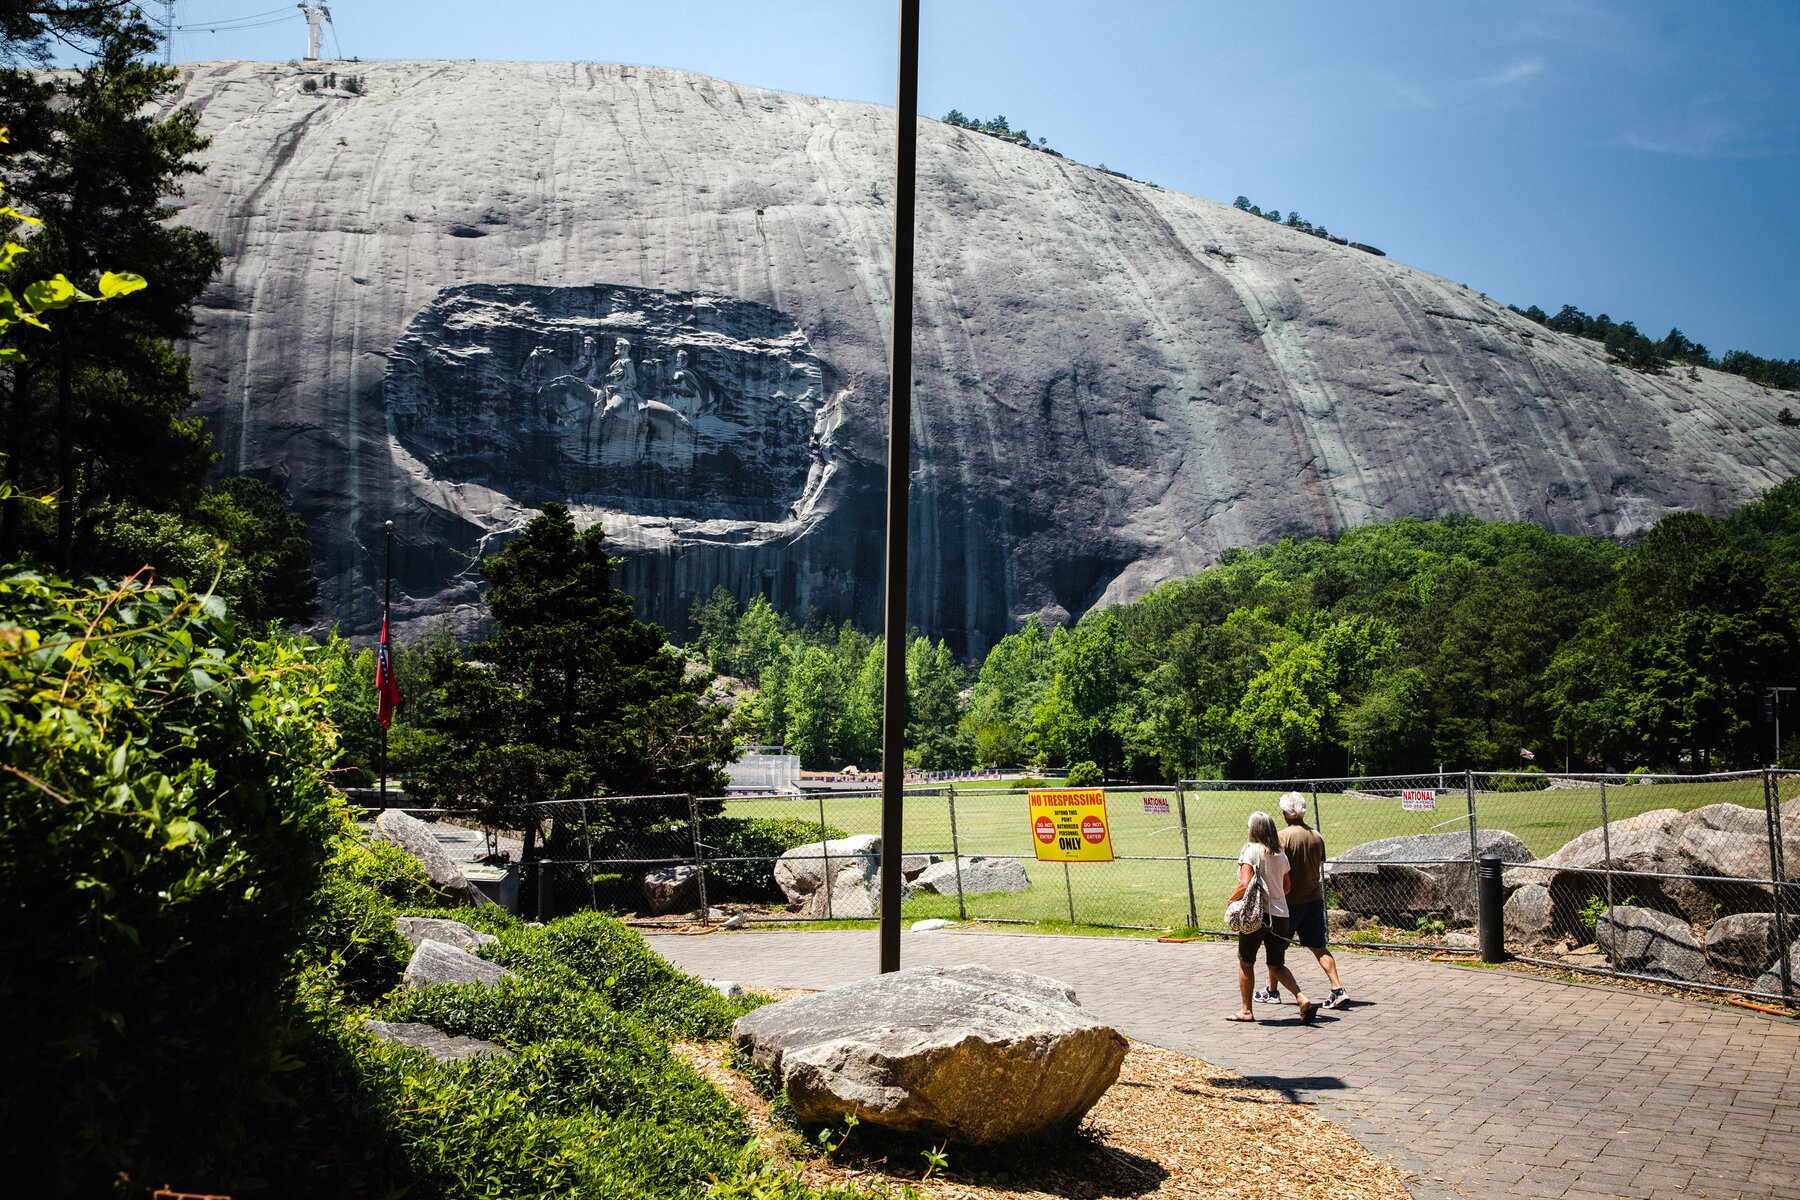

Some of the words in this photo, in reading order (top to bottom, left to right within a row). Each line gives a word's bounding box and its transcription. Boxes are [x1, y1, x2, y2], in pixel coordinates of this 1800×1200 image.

[1031, 794, 1041, 806] NO
[1043, 793, 1102, 806] TRESPASSING
[1403, 791, 1434, 800] NATIONAL
[1144, 798, 1169, 806] NATIONAL
[1059, 838, 1081, 850] ONLY
